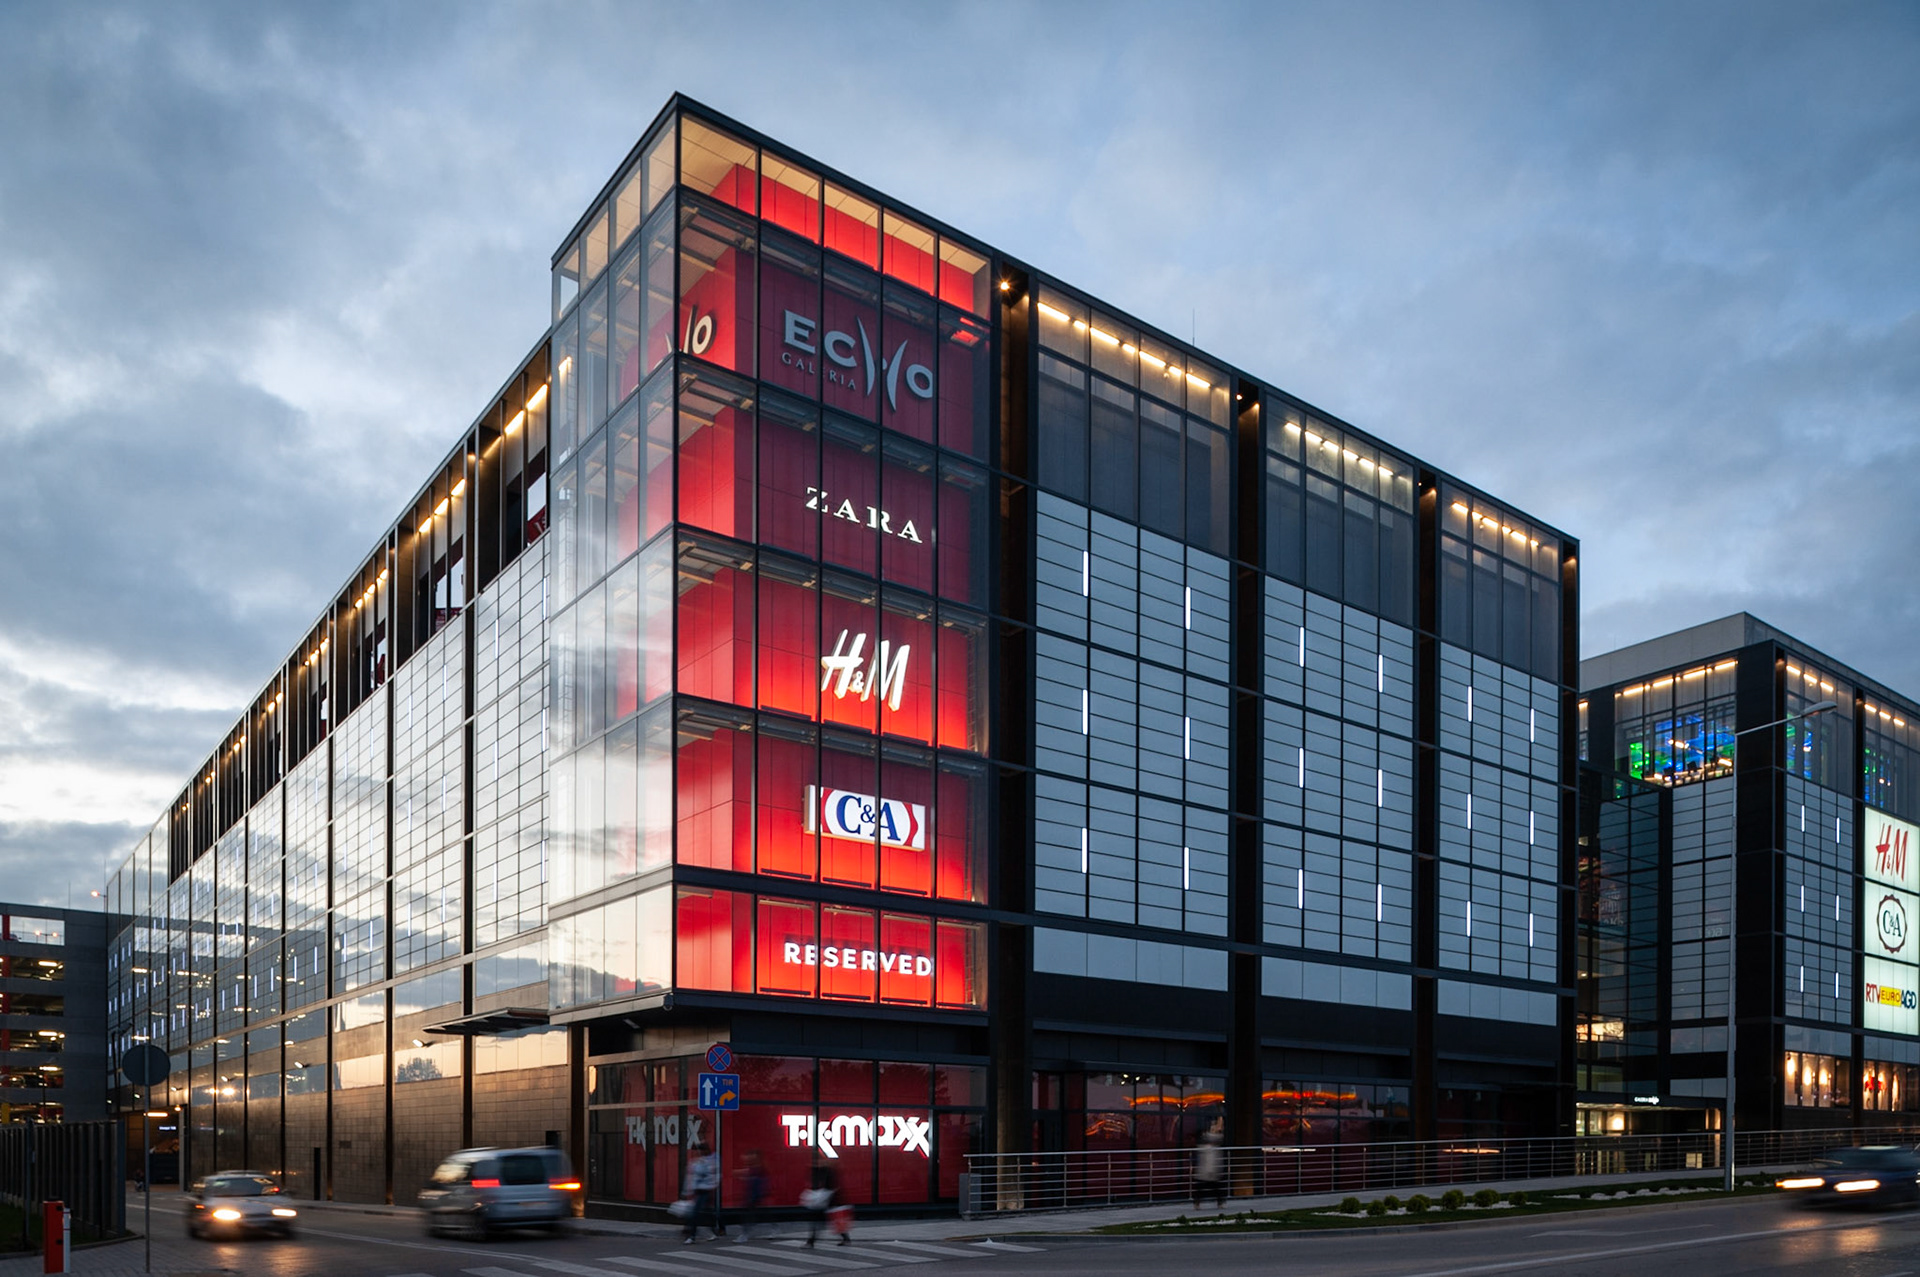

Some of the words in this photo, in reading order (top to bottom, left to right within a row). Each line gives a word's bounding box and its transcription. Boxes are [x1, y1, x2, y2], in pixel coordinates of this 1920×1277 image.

[781, 352, 856, 390] GALRIA
[806, 487, 922, 543] ZARA
[821, 629, 910, 711] H&M
[836, 794, 901, 841] C&A
[1876, 823, 1908, 881] H&M
[1882, 910, 1902, 937] C&A
[784, 942, 932, 976] RESERVED
